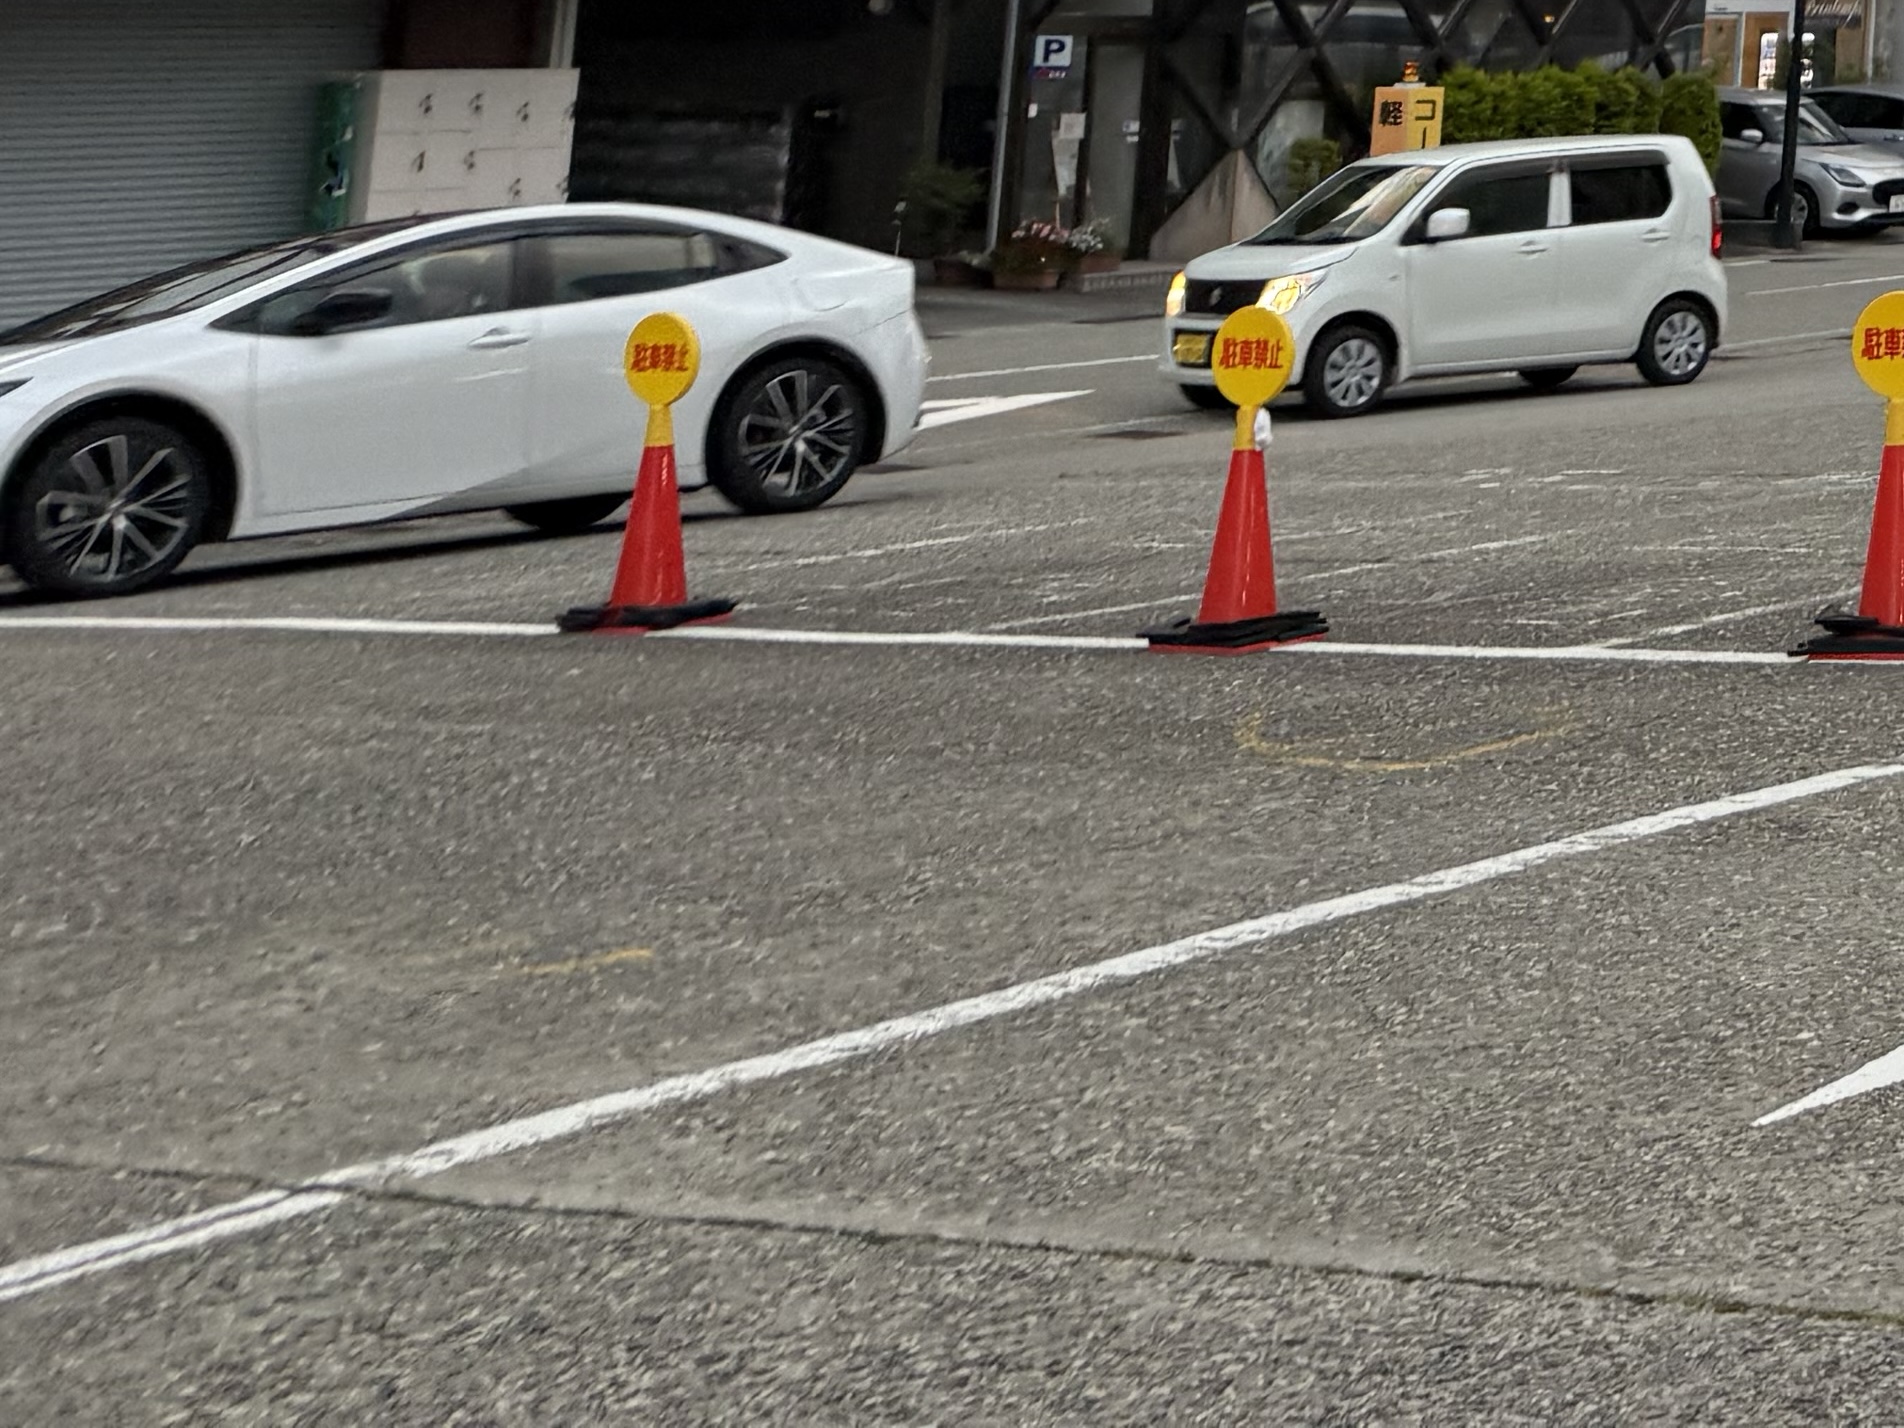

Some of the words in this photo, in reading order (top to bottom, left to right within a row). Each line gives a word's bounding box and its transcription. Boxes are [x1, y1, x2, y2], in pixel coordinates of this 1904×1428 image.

[1043, 39, 1066, 63] P
[1219, 337, 1284, 369] 駐車禁止
